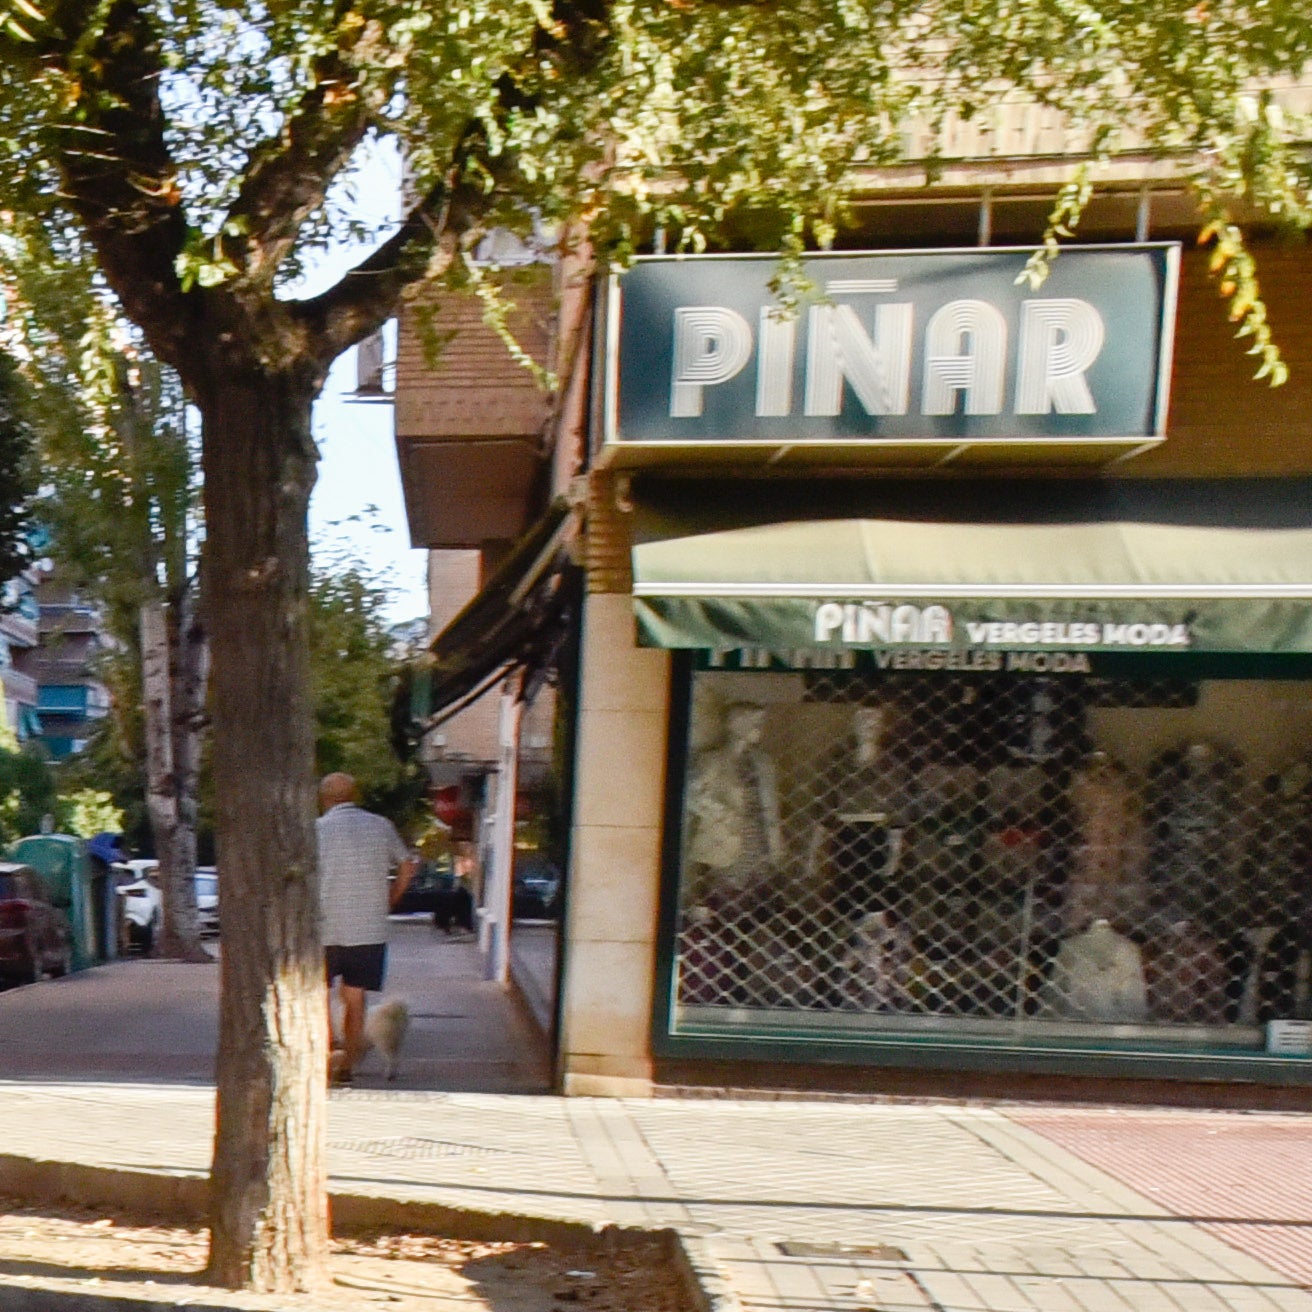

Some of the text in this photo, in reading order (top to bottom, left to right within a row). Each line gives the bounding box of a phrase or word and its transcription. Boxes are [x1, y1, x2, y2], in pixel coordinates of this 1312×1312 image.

[669, 278, 1105, 418] PIÑAR
[966, 622, 1100, 644] VERGELES
[1102, 623, 1190, 645] MODA
[876, 650, 1002, 671] VERGELES
[1006, 651, 1092, 673] MODA
